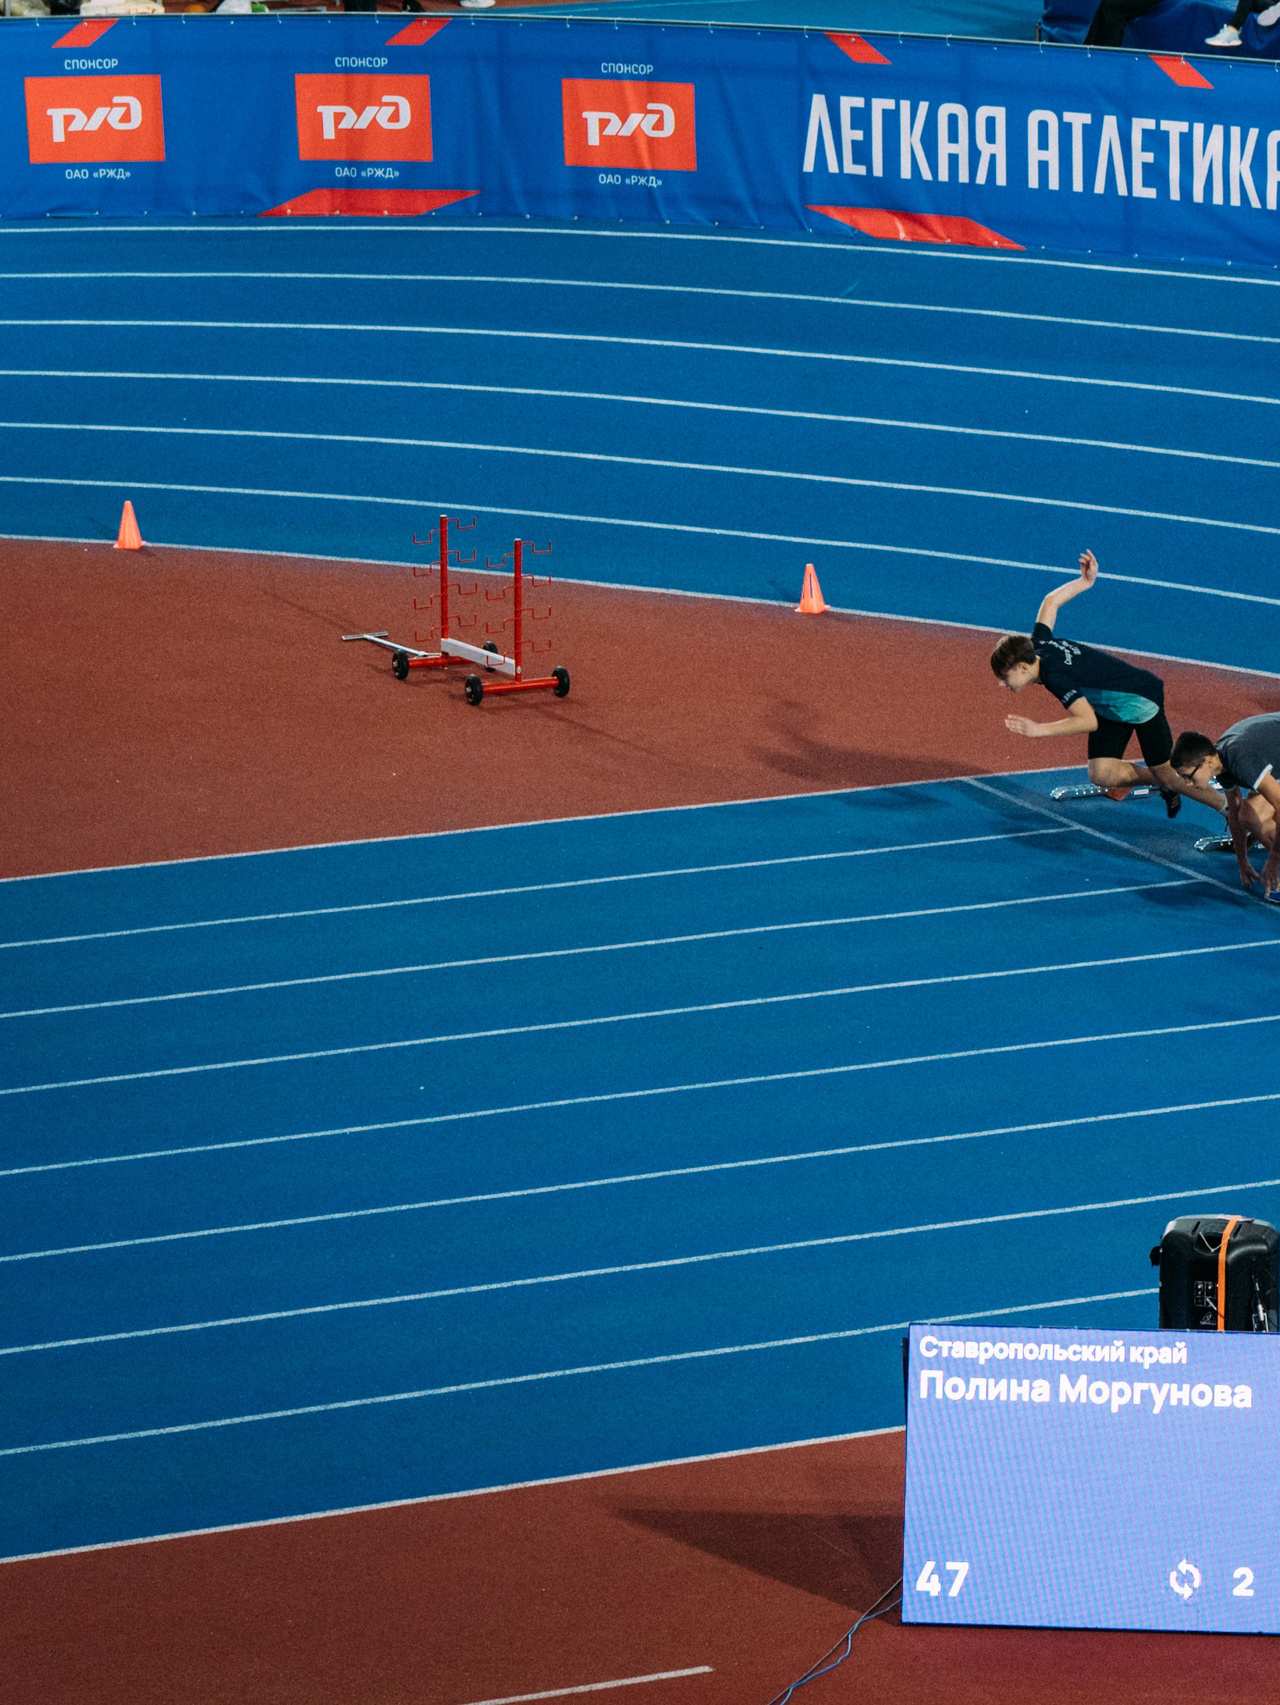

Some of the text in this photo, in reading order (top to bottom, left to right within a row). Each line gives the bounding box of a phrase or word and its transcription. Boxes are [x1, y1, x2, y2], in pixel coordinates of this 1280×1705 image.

[64, 58, 119, 70] СПОНСОР
[334, 56, 388, 68] СПОНСОР
[601, 62, 654, 75] СПОНСОР
[802, 94, 1007, 186] ЛЕГКАЯ
[65, 168, 131, 180] ОАО «РЖД»
[335, 166, 400, 179] ОАО «РЖД»
[598, 173, 663, 188] ОАО «РЖД»
[919, 1335, 1188, 1369] Ставропольский край
[919, 1369, 1252, 1414] Полина Моргунова
[916, 1561, 969, 1597] 47
[1232, 1566, 1254, 1597] 2
